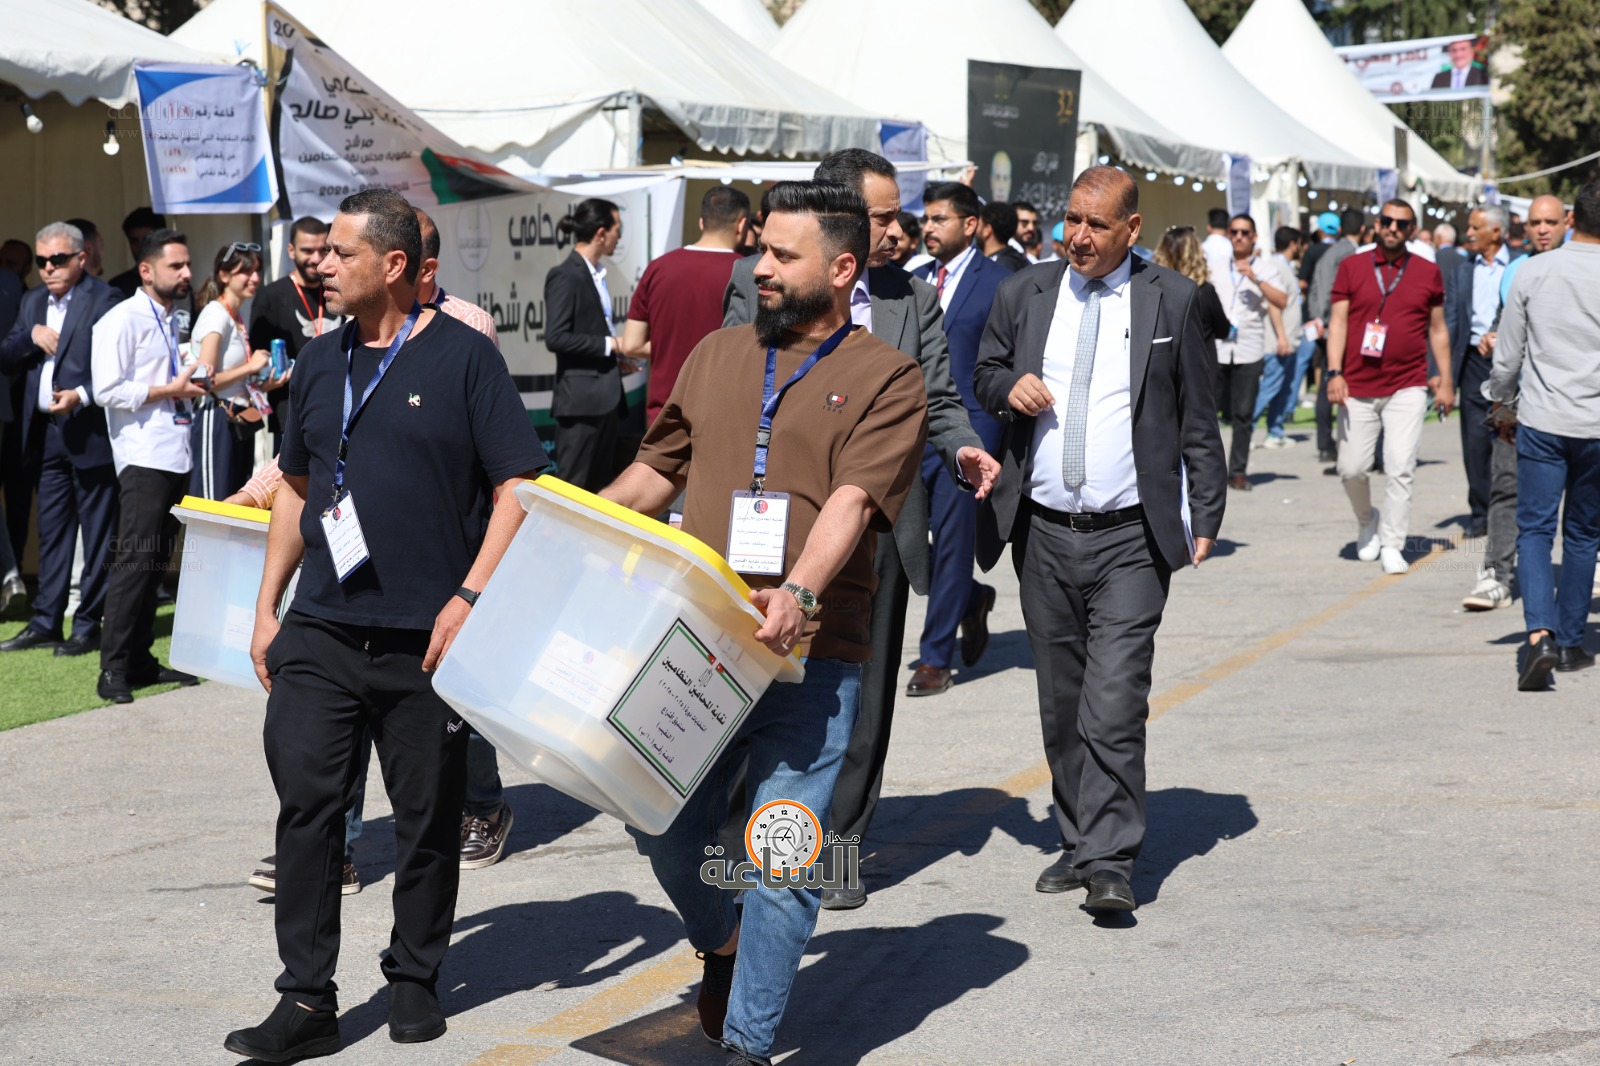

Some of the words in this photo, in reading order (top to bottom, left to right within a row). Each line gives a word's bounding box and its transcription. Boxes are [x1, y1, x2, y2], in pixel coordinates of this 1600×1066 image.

[288, 100, 340, 122] صالح
[345, 134, 374, 150] مرشح
[688, 685, 713, 710] المحامين
[711, 705, 726, 725] نقابة
